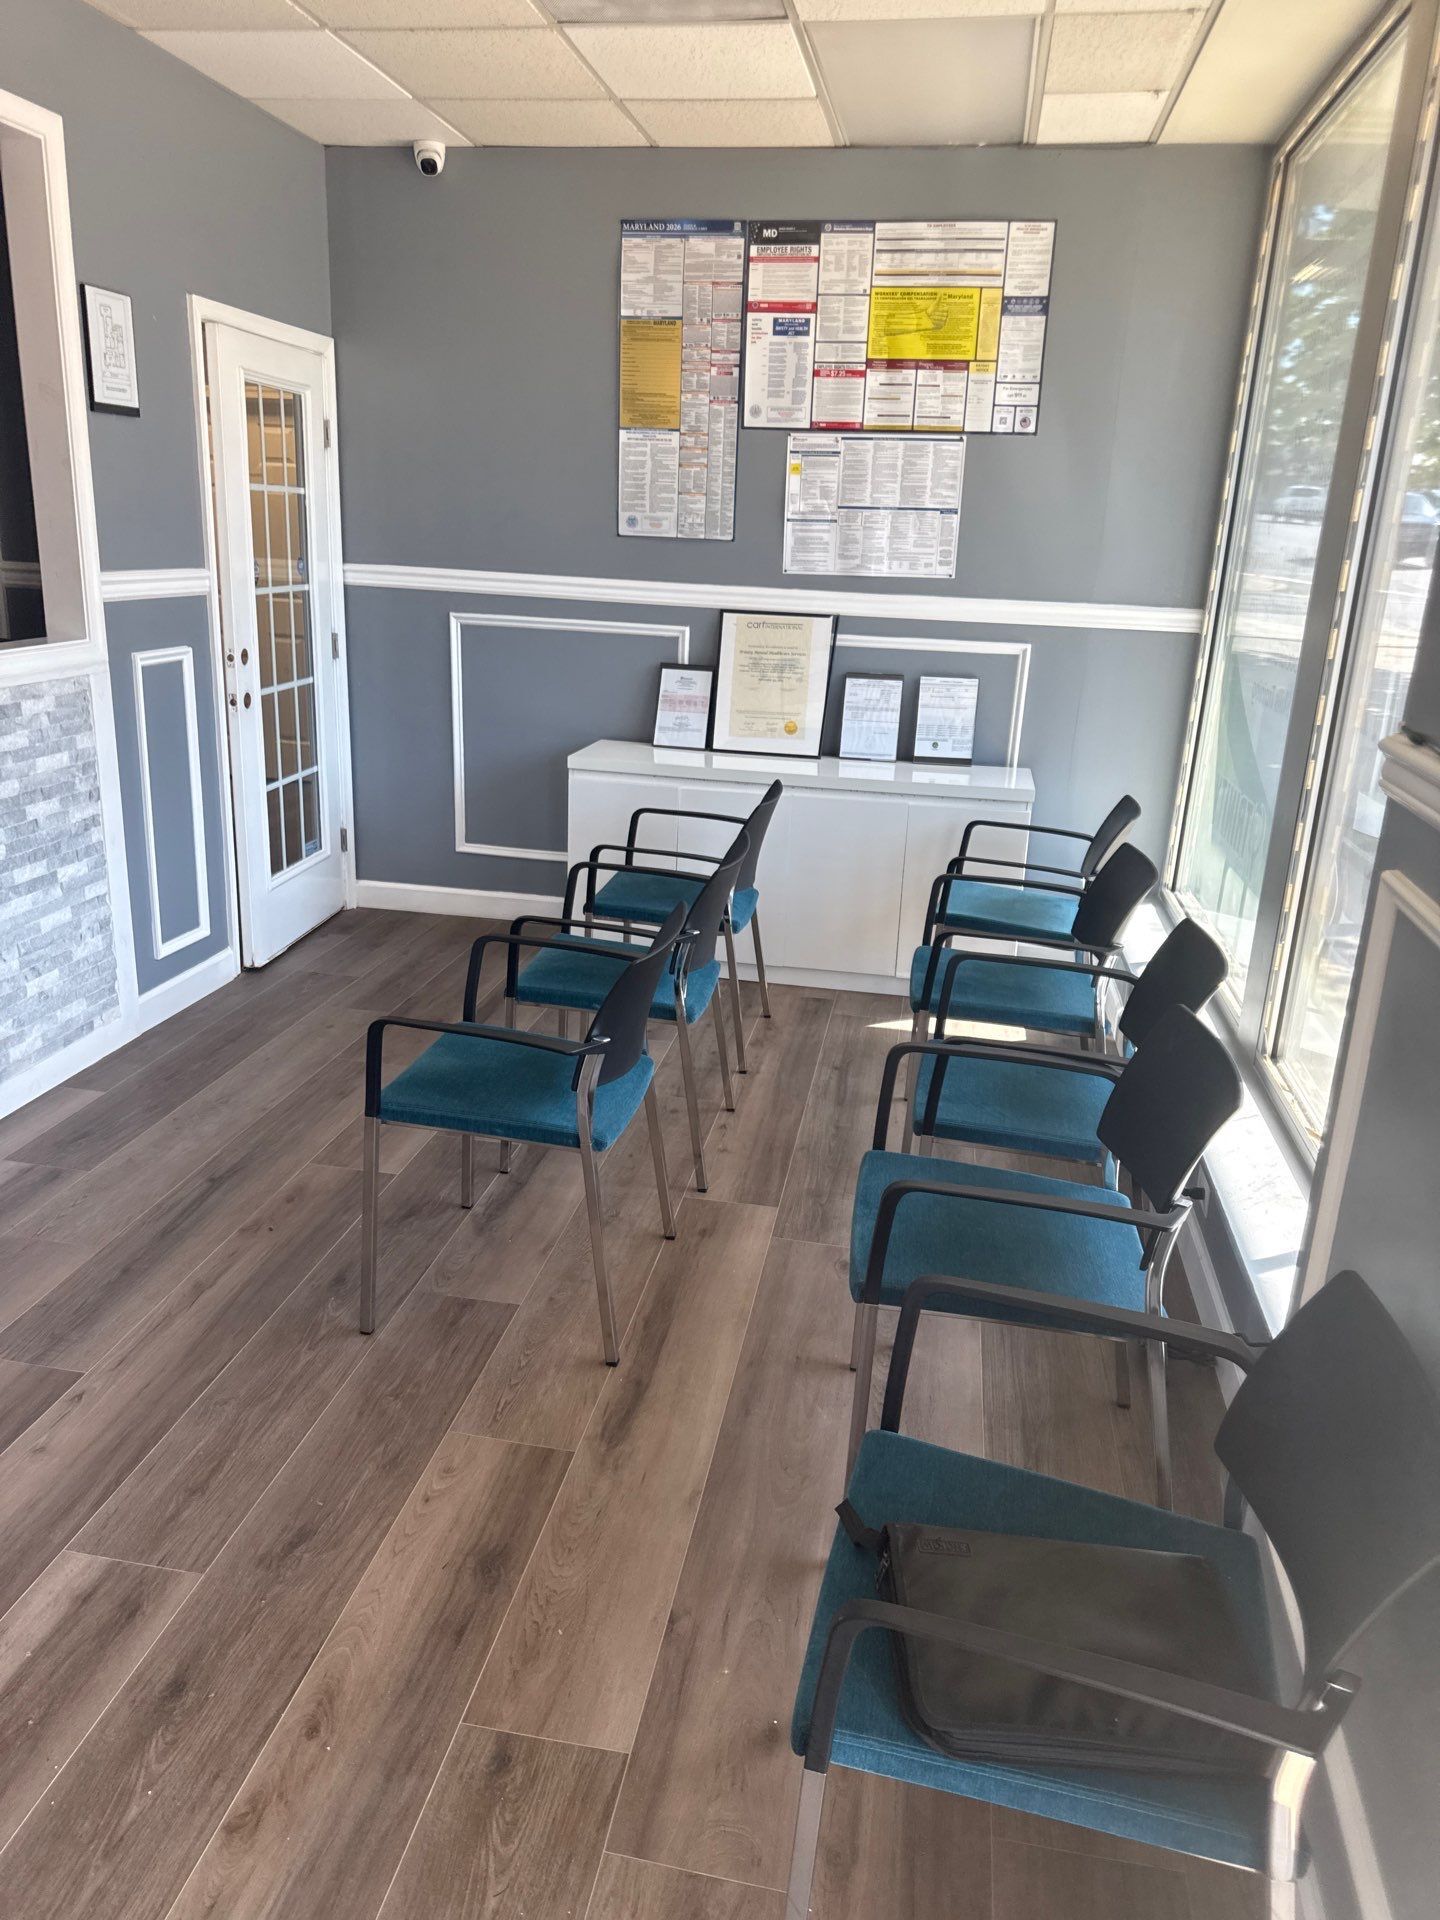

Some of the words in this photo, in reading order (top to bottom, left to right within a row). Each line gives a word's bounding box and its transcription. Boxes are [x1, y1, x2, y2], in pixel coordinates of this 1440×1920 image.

[622, 222, 665, 231] MARYLAND
[666, 223, 682, 231] 2026
[762, 229, 778, 238] MD
[756, 246, 788, 254] EMPLOYEE
[789, 246, 812, 254] RIGHTS
[746, 620, 766, 629] carf
